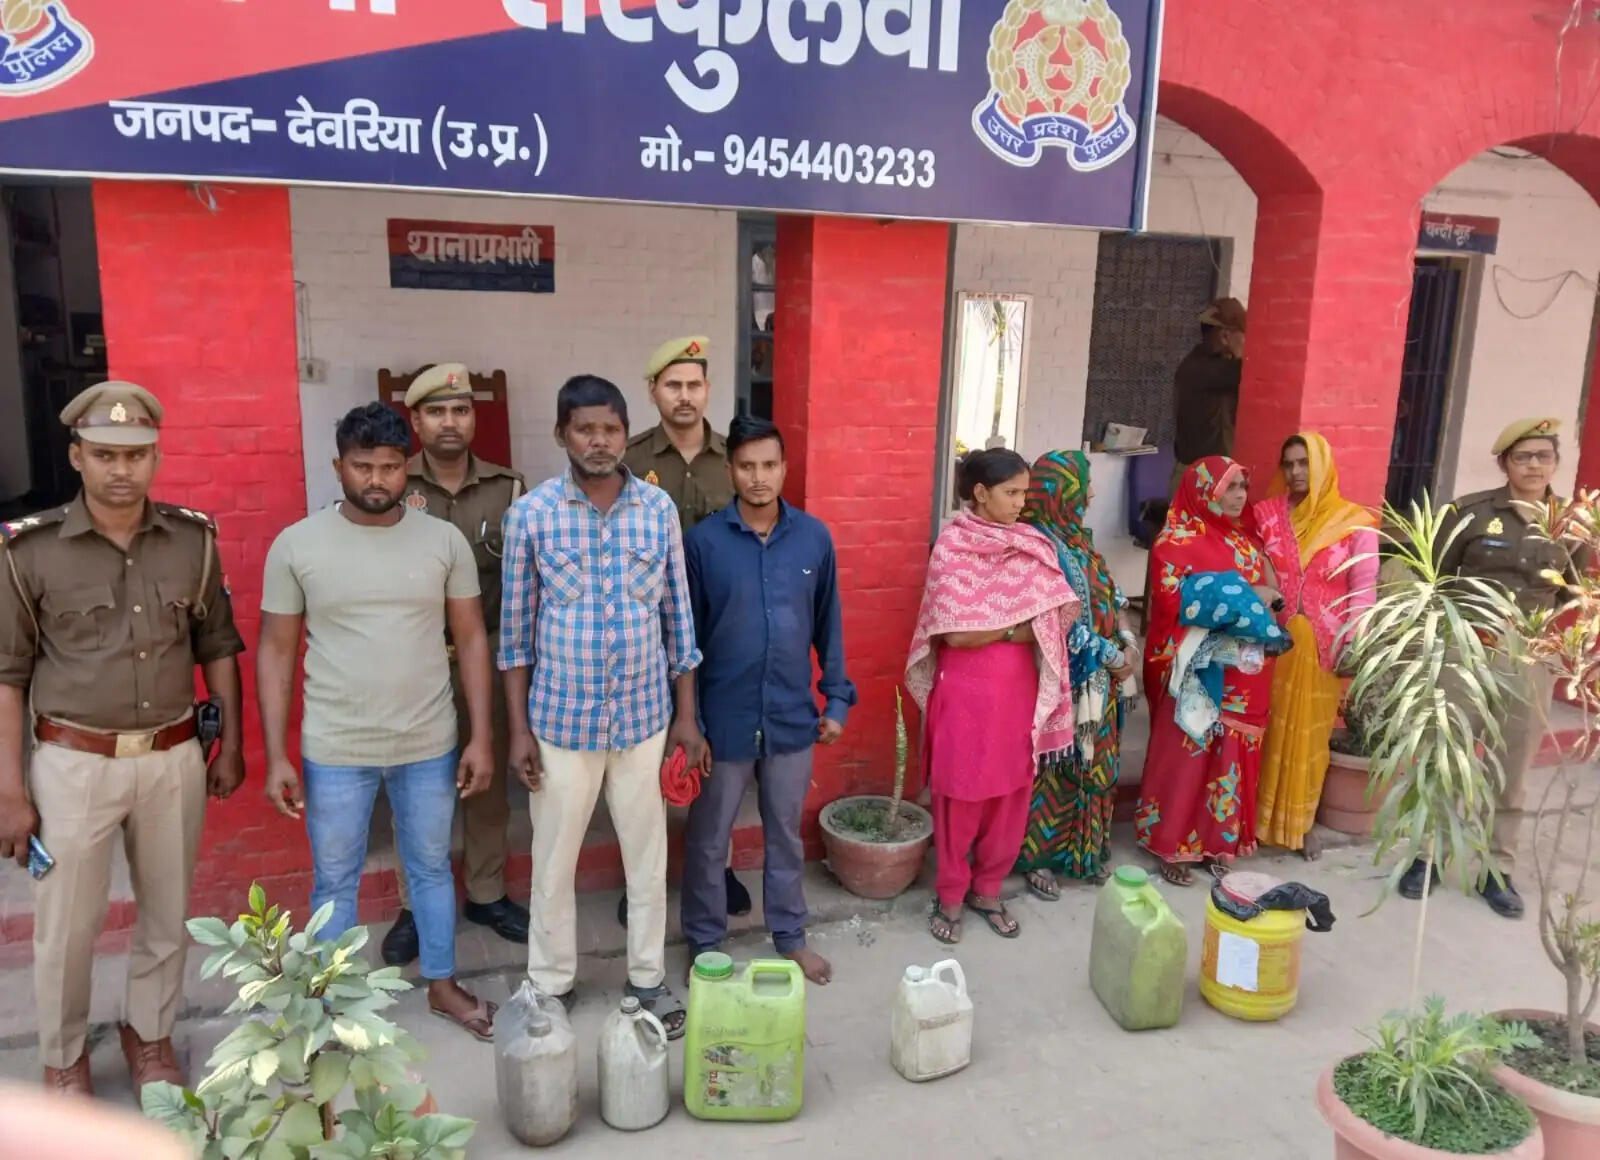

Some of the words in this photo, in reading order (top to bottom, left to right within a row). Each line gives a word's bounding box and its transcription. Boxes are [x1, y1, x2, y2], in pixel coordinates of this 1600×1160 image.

[3, 32, 74, 82] पुलिस
[109, 100, 277, 144] जनपद-
[285, 96, 422, 154] देवरिया
[432, 105, 549, 176] (उ.प्र.)
[723, 134, 936, 188] 9454403233
[1032, 117, 1078, 142] प्रदेश
[1084, 124, 1126, 162] पुलिस
